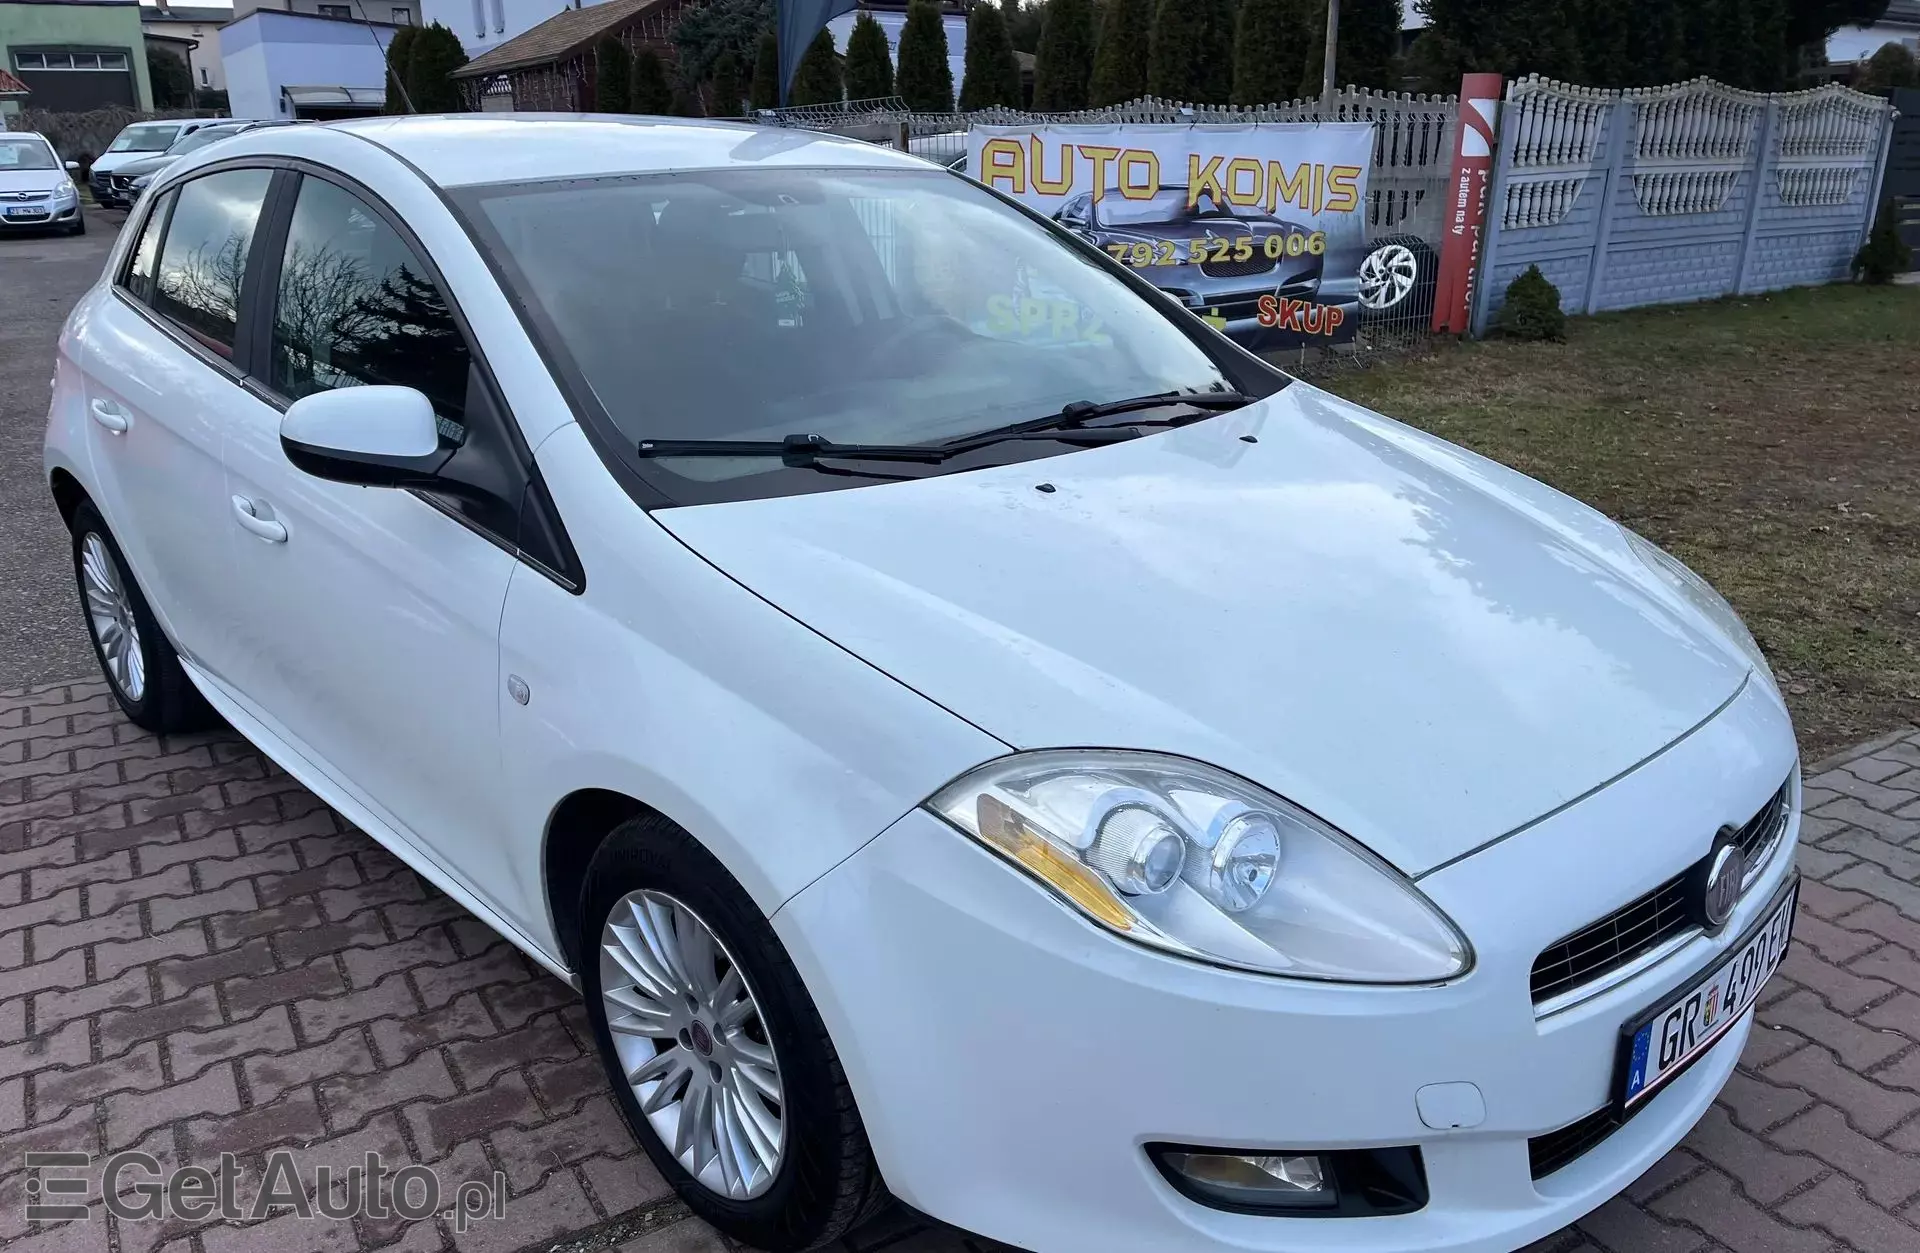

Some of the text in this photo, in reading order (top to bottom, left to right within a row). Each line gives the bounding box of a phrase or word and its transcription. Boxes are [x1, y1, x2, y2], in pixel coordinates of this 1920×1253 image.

[981, 132, 1363, 216] AUTO KOMIS
[1457, 176, 1470, 208] autem
[1451, 224, 1466, 236] ty
[1455, 210, 1466, 223] na
[1107, 230, 1327, 268] 792 525 006
[1257, 294, 1345, 337] SKUP
[1658, 991, 1702, 1071] GR
